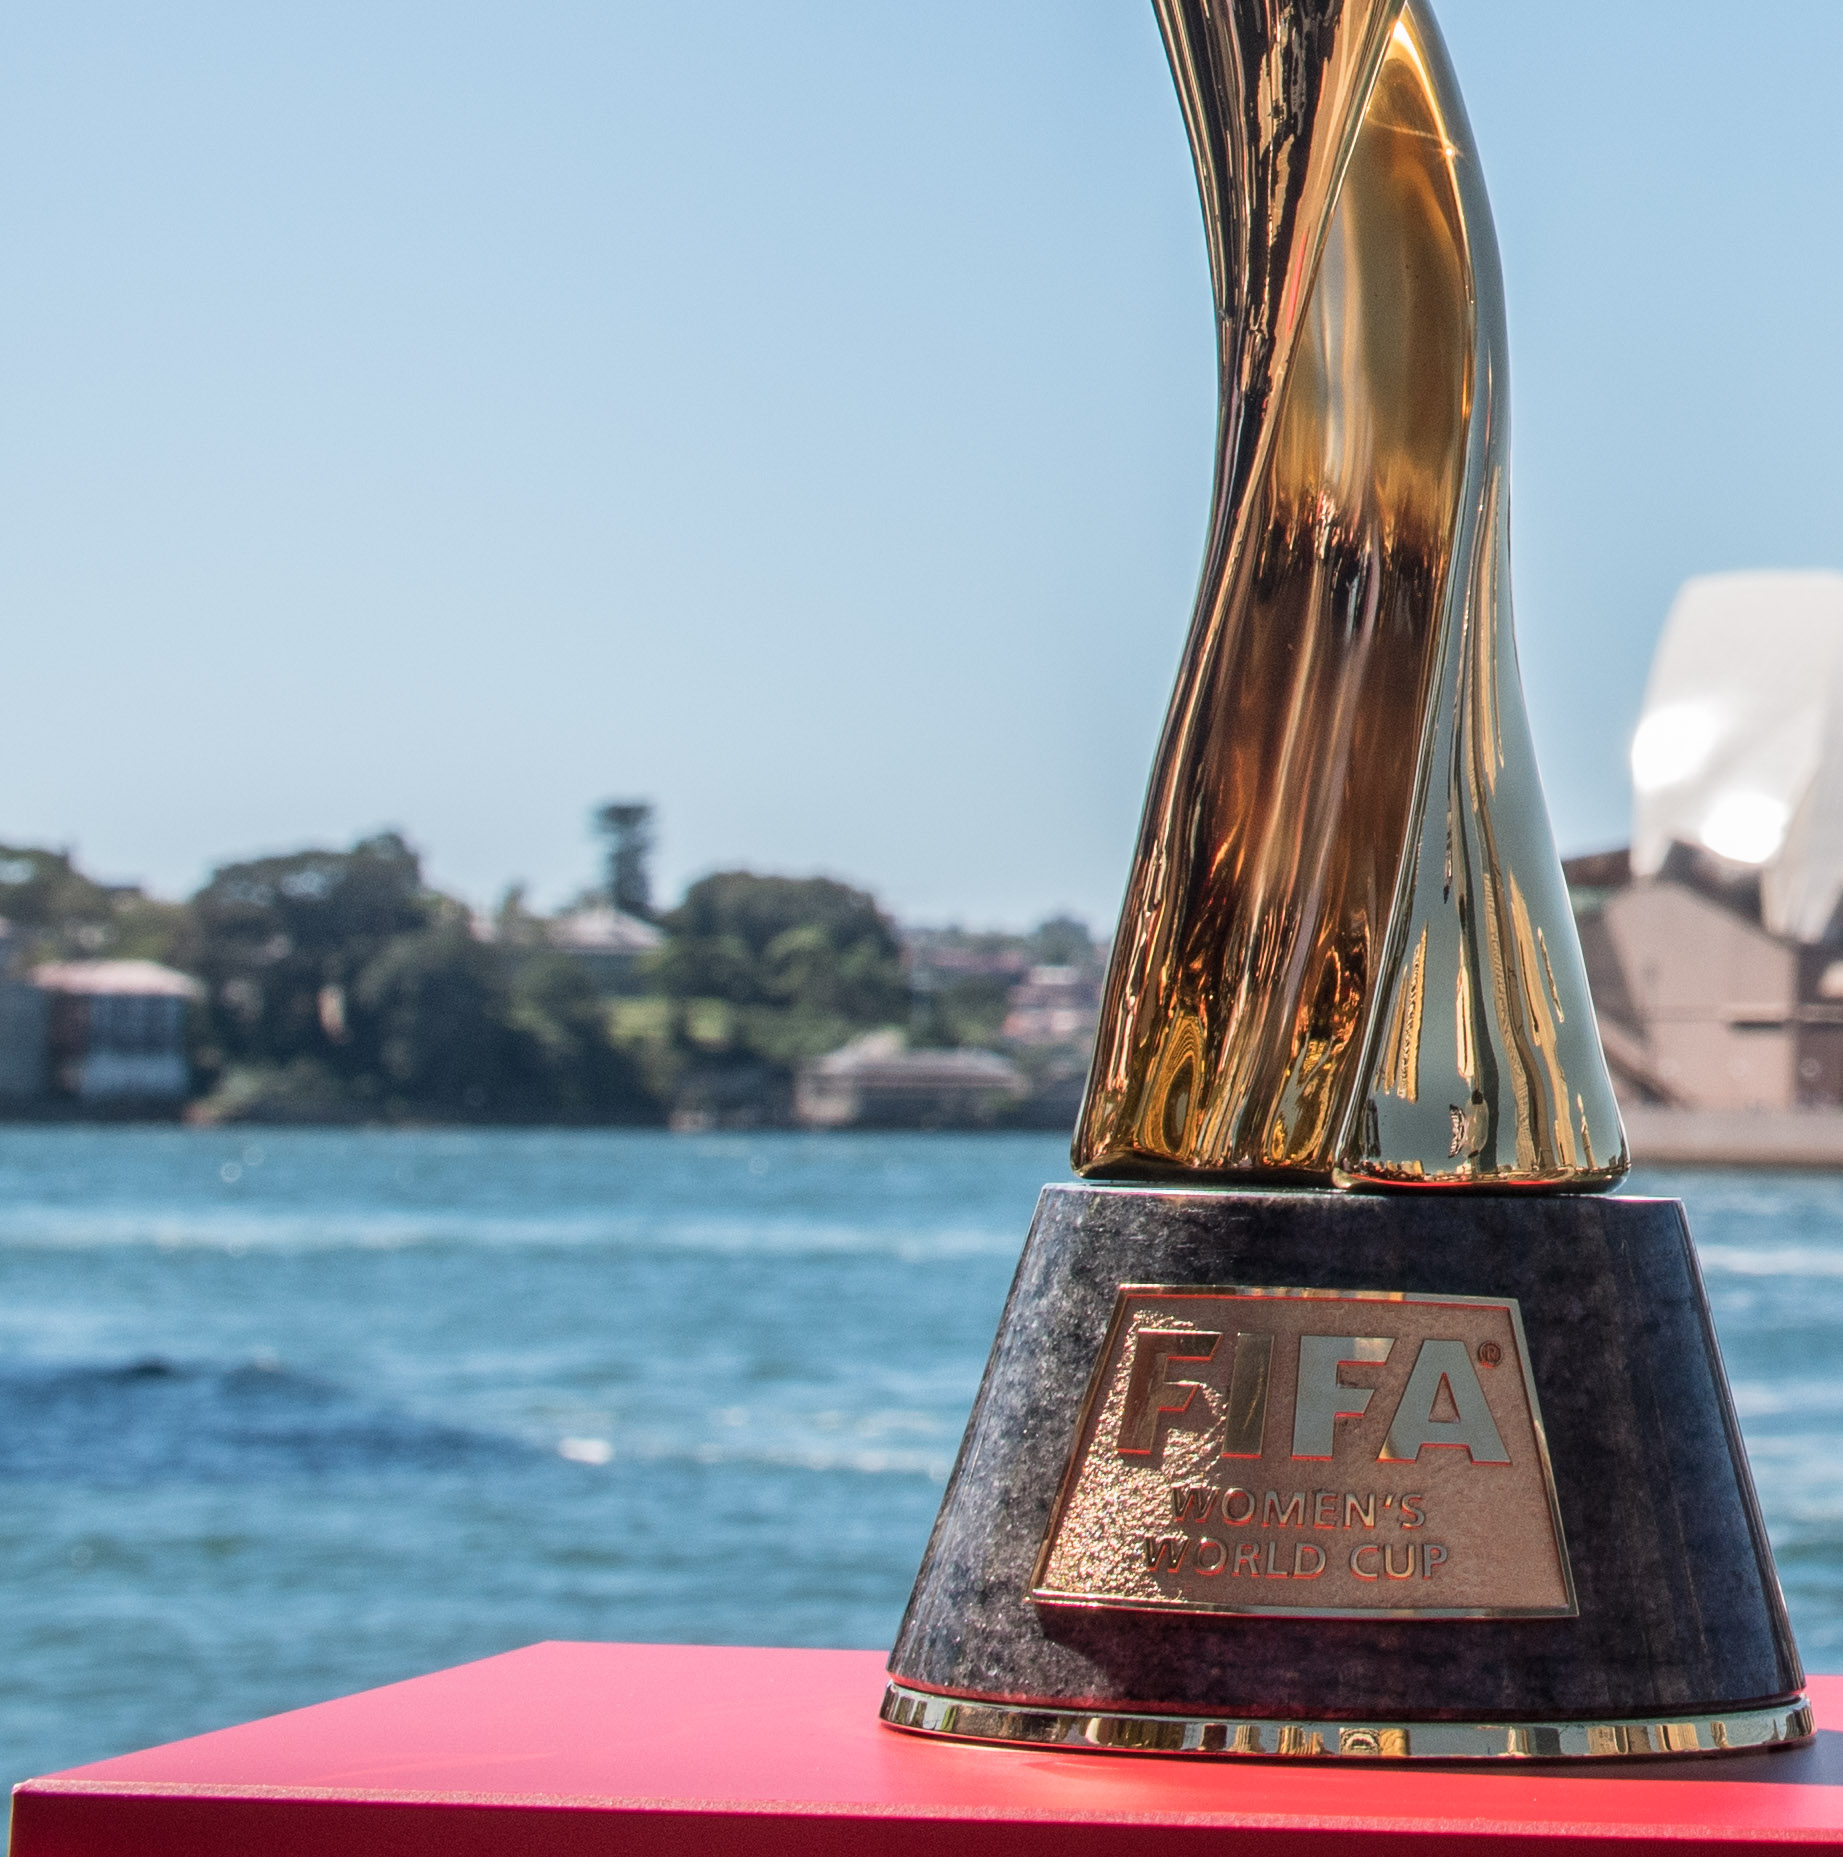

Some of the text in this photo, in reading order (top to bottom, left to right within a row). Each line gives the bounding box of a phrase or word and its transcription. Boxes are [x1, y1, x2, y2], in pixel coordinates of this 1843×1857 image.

[1170, 1485, 1426, 1529] WOMEN'S
[1144, 1536, 1448, 1581] WORLD CUP
